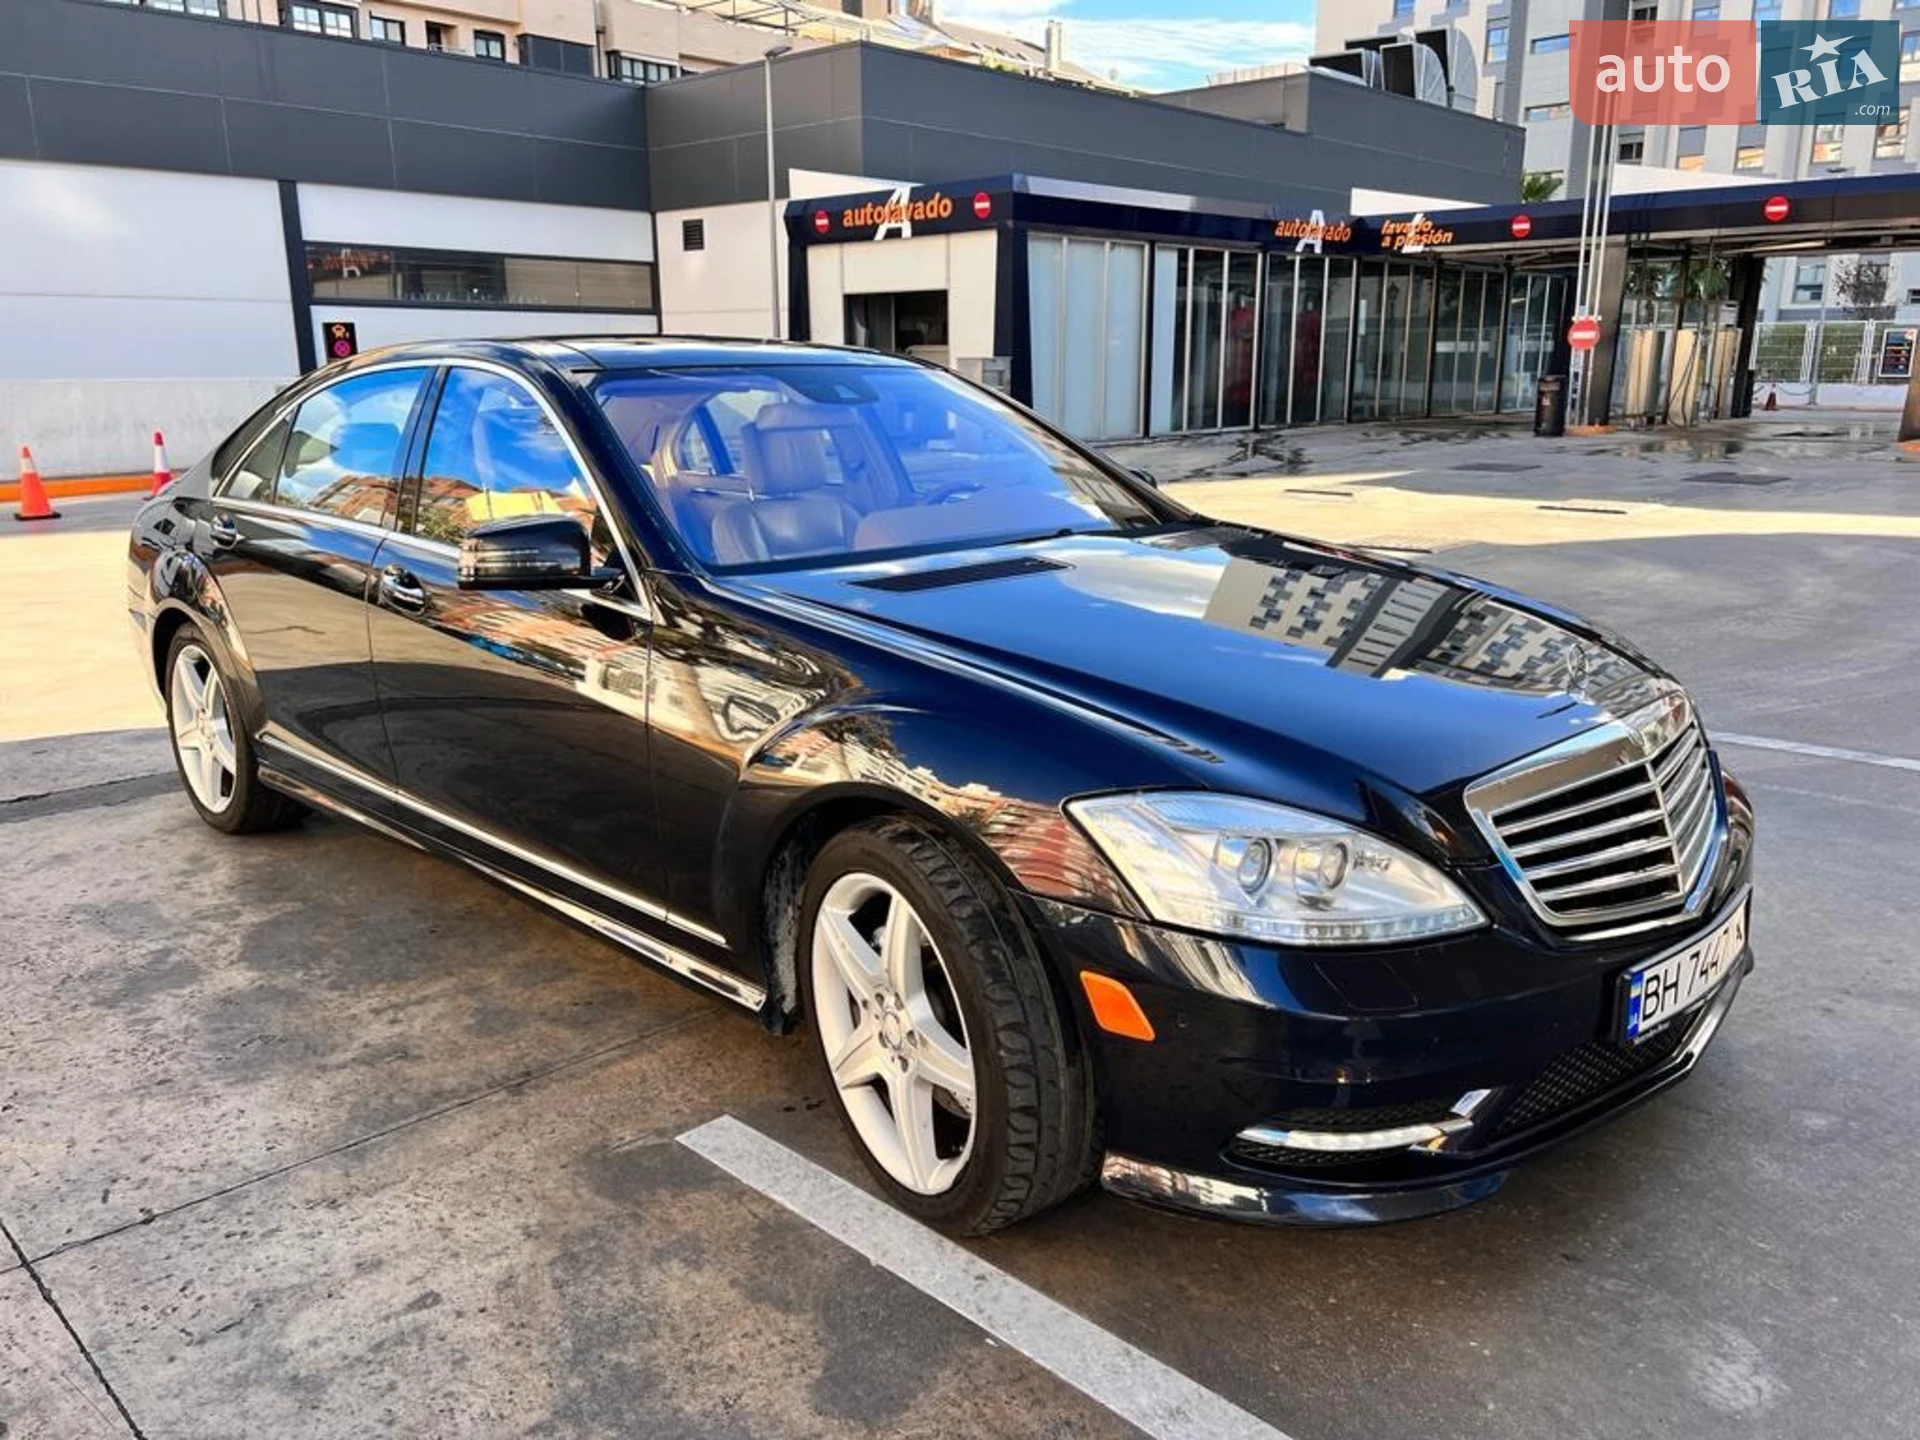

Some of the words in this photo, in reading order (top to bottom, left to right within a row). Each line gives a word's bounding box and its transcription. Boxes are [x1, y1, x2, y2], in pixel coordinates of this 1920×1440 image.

[842, 191, 953, 227] autolavado
[1274, 217, 1352, 242] autolavado
[1381, 235, 1391, 247] a
[1393, 230, 1453, 250] presión
[1641, 961, 1682, 1022] BH
